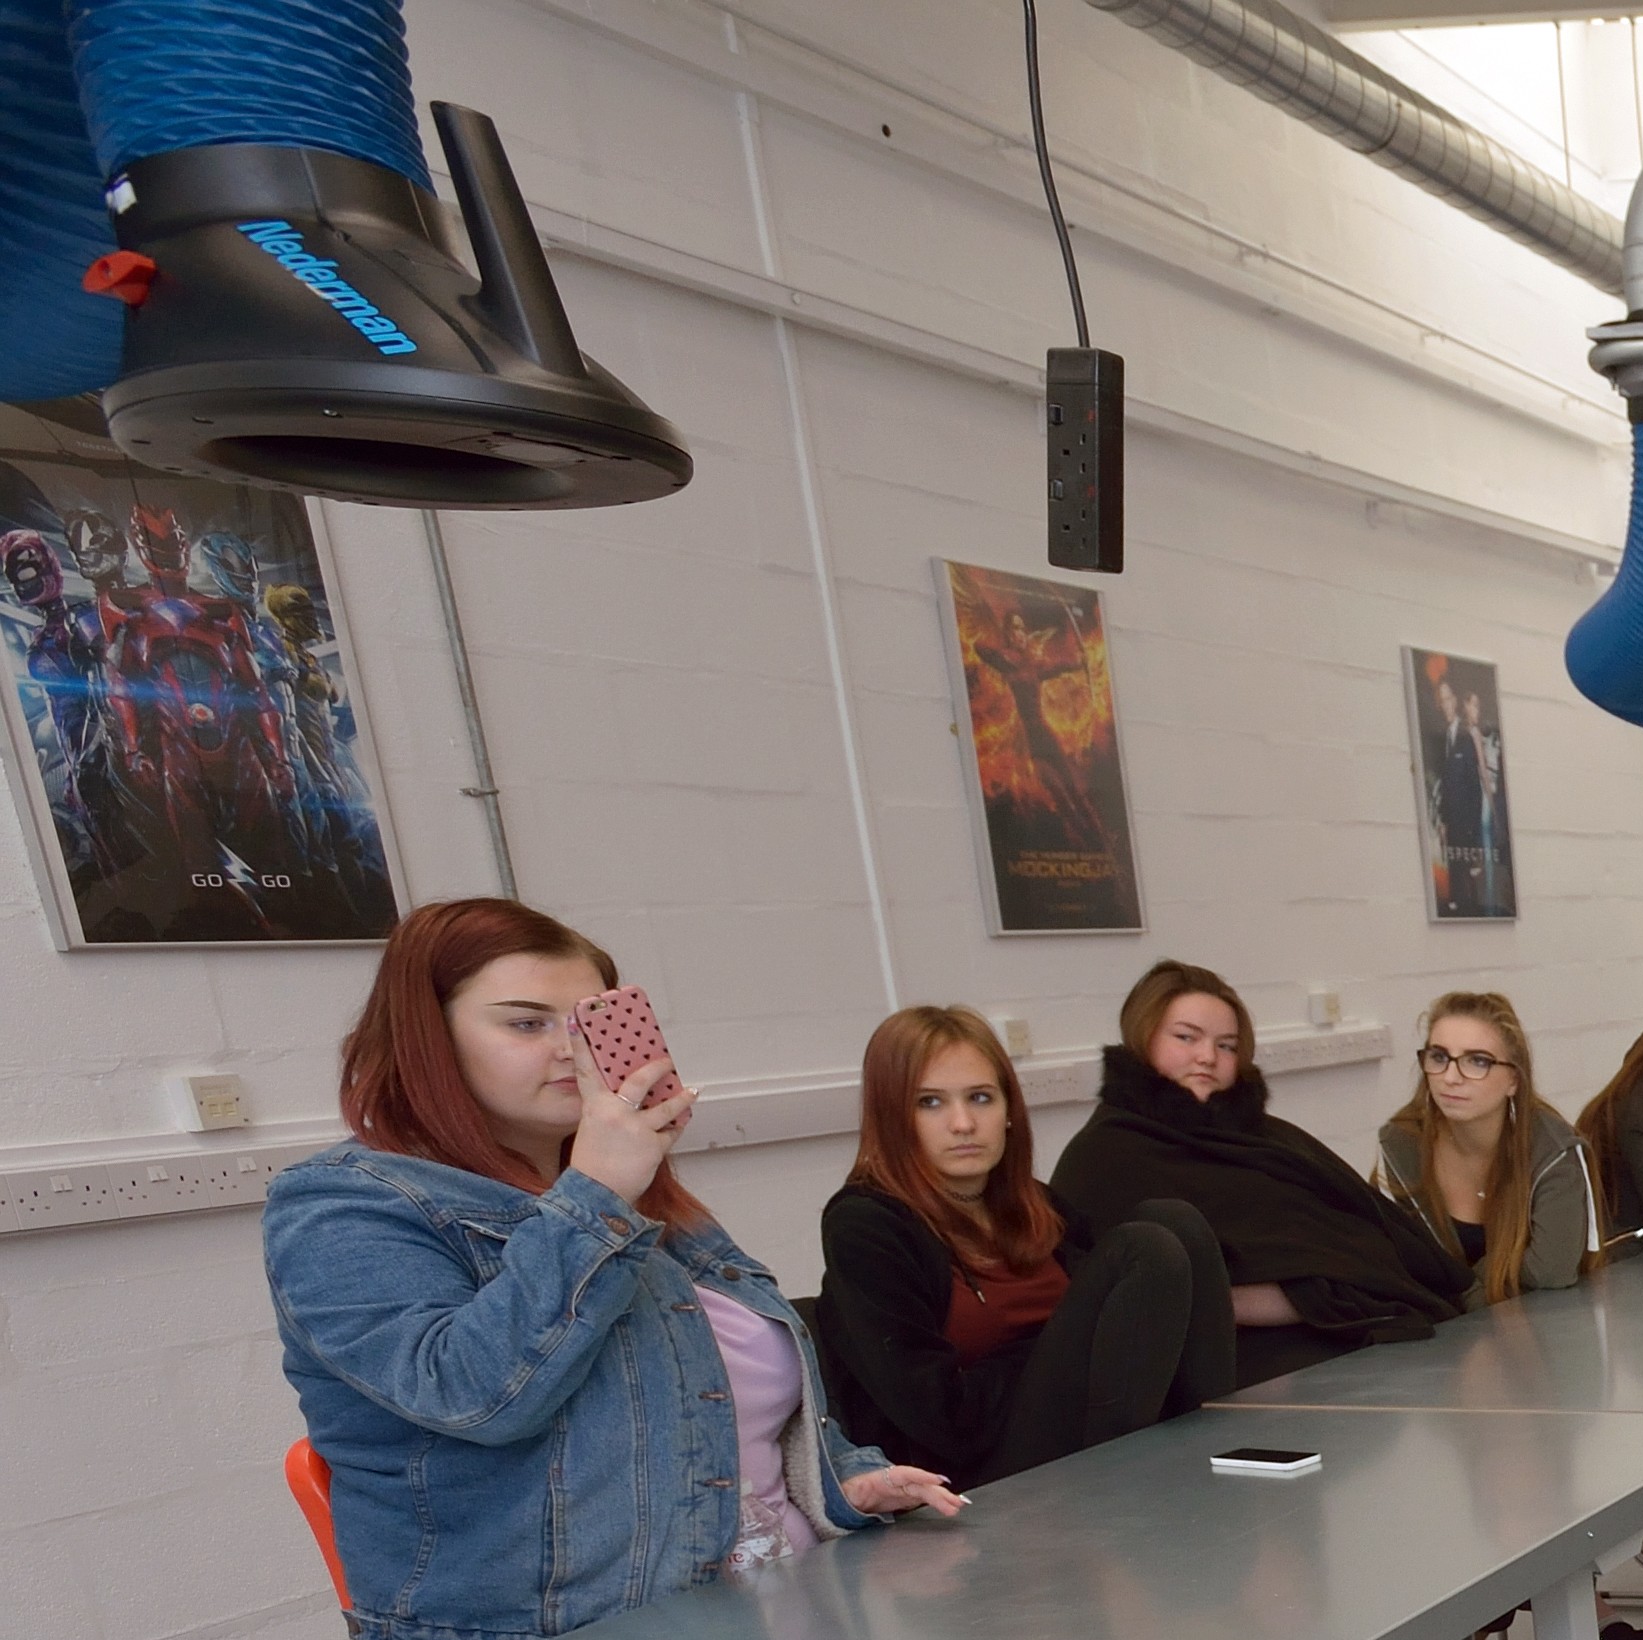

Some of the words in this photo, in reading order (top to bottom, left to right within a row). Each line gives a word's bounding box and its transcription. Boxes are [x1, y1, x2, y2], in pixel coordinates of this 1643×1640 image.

[236, 218, 418, 356] Nederman
[191, 873, 223, 887] GO
[261, 874, 291, 888] GO
